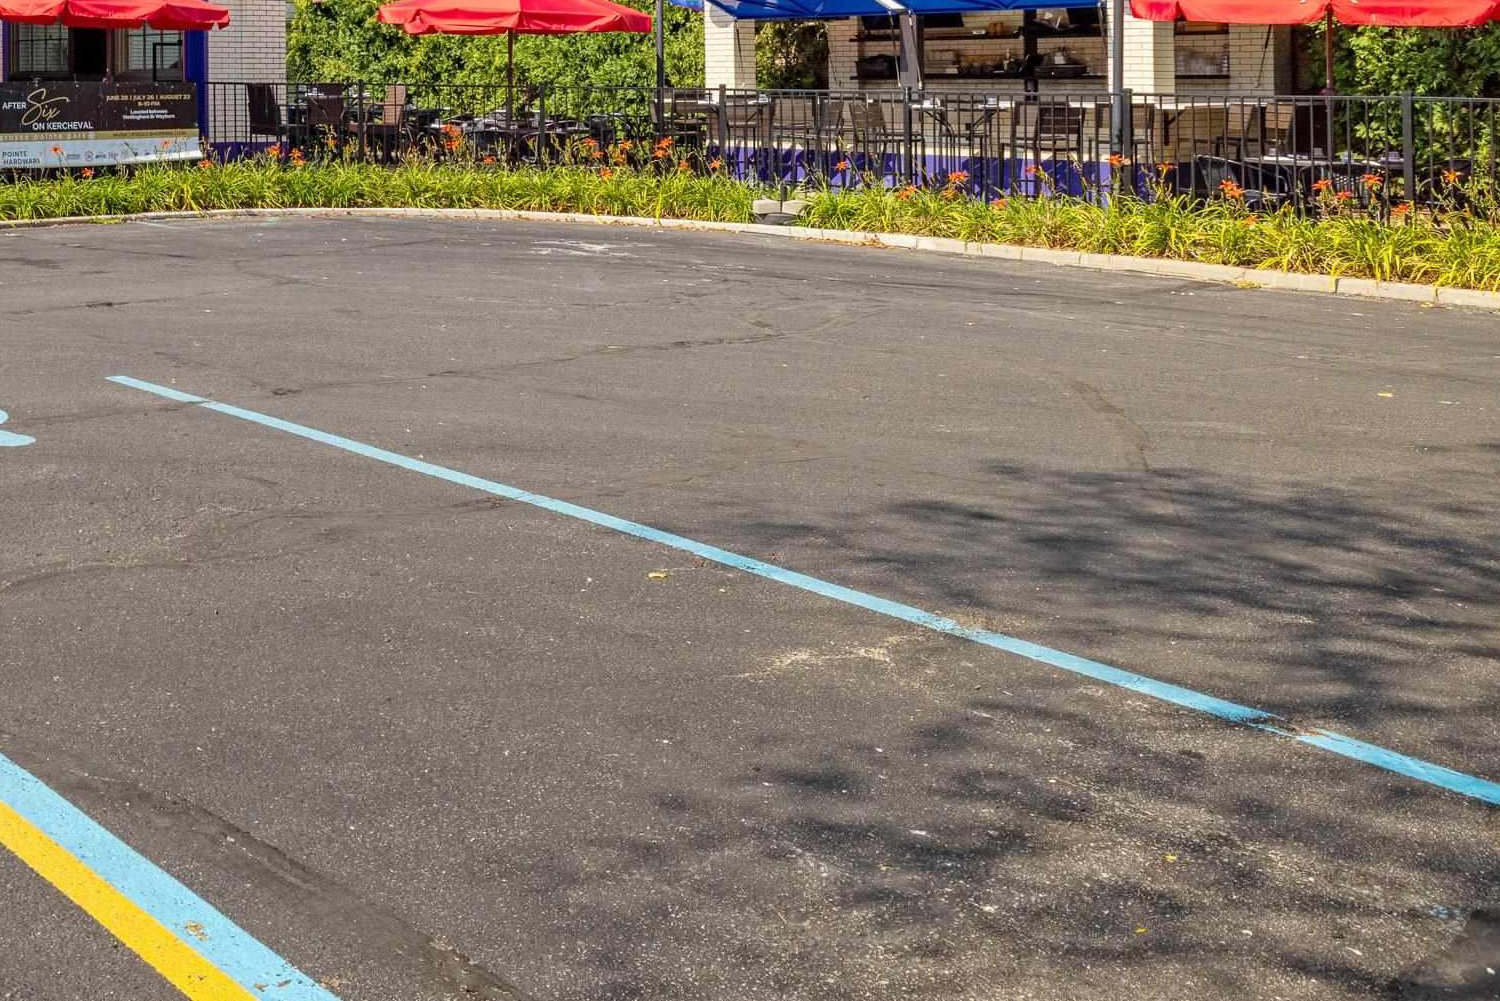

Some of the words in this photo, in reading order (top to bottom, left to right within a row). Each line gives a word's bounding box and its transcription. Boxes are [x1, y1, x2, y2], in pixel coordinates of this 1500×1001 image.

[2, 101, 27, 110] AFTER
[21, 88, 70, 125] Six
[32, 122, 45, 130] ON
[46, 121, 94, 130] KERCHEVAL
